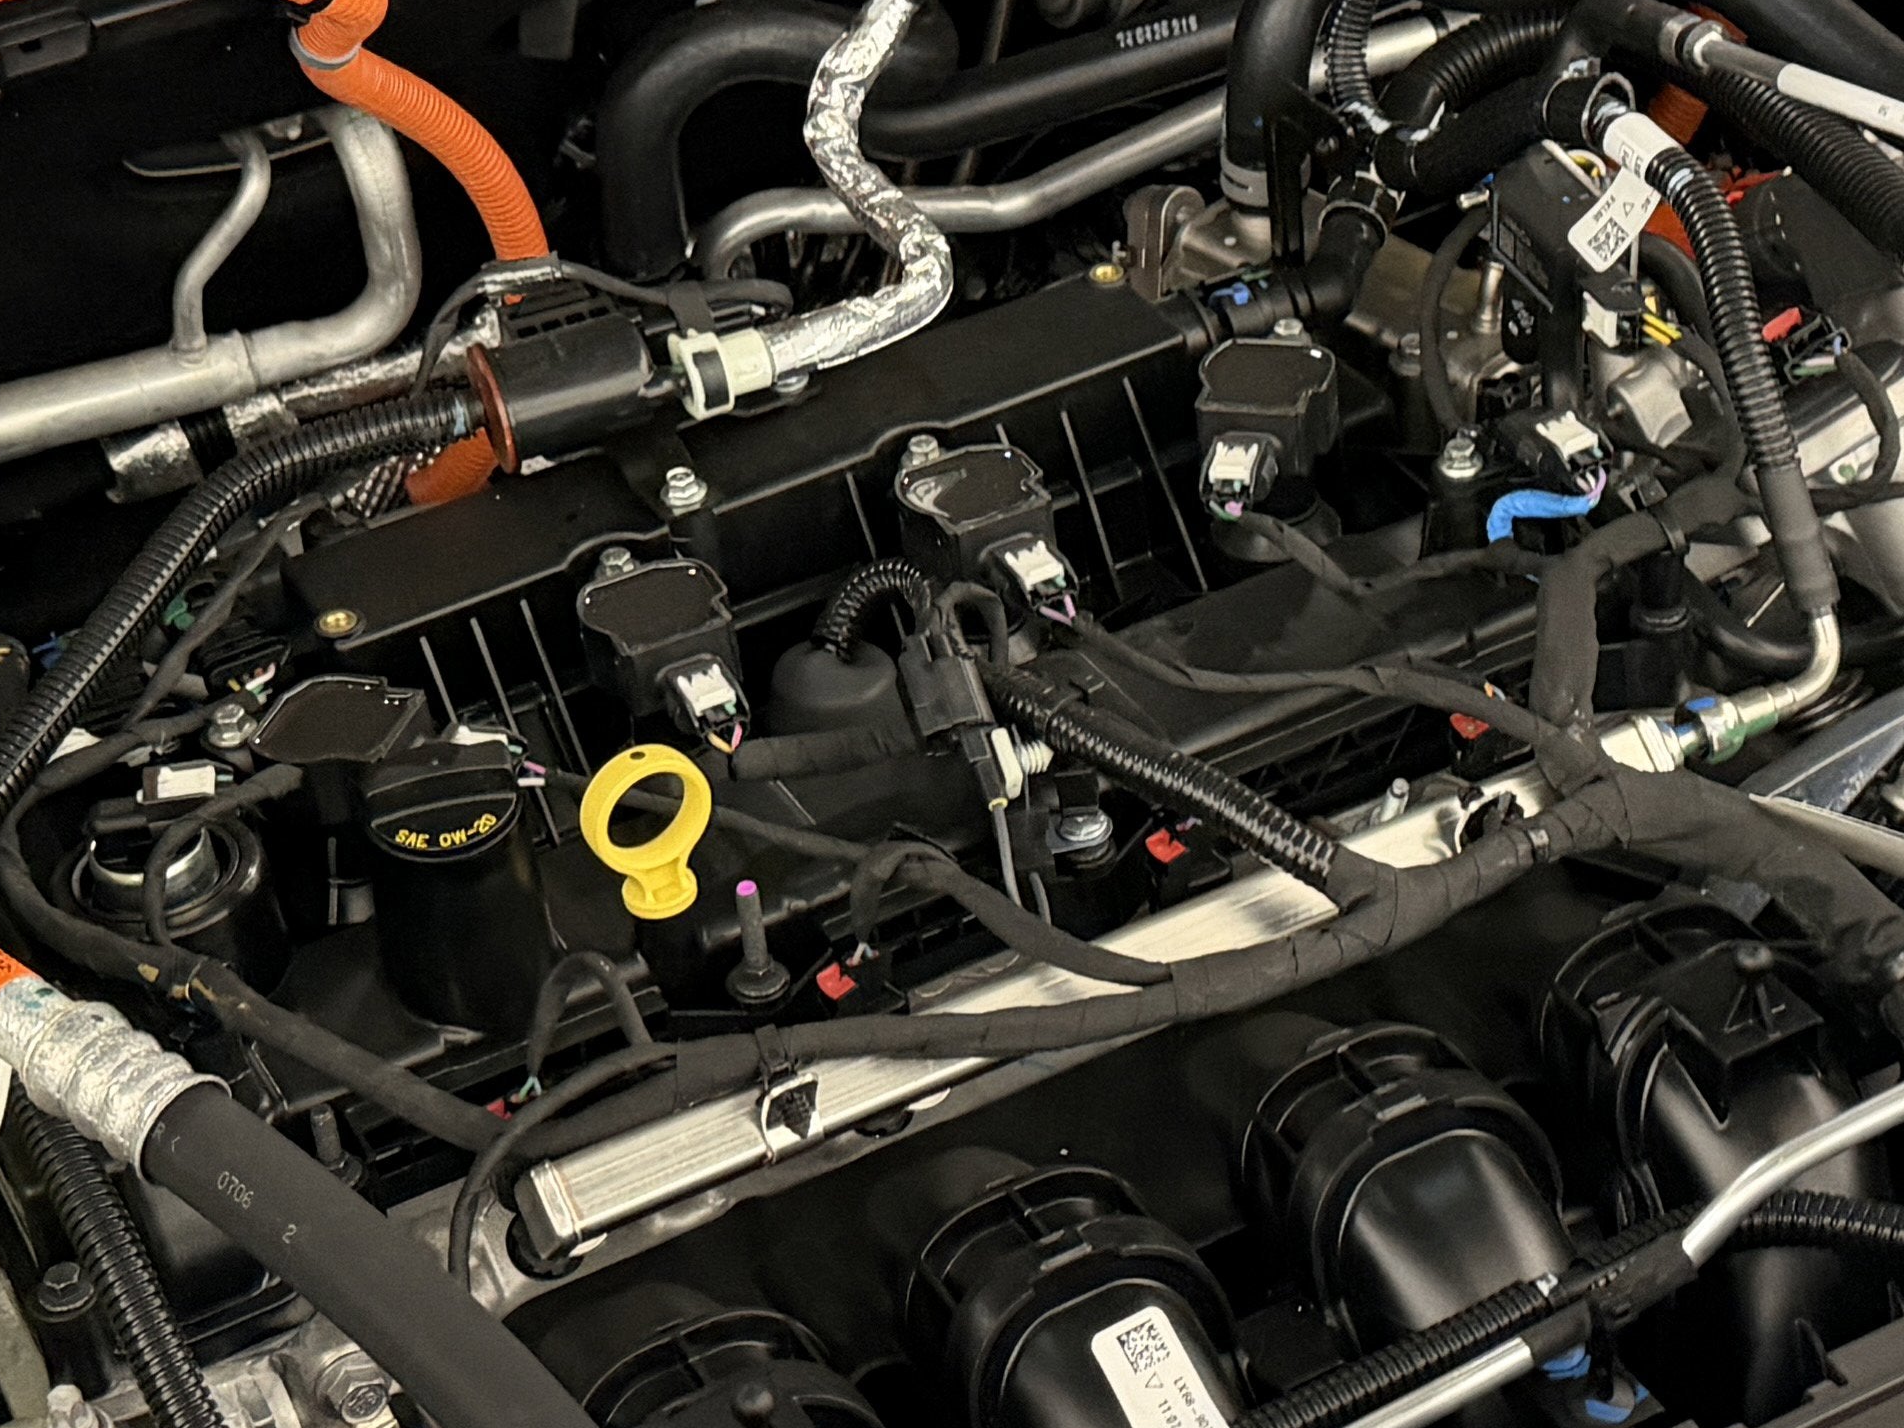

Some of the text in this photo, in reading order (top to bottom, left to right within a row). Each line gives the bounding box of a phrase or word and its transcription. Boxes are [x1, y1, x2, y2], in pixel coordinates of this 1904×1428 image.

[395, 828, 430, 850] SAE
[217, 1171, 297, 1245] 0706 2
